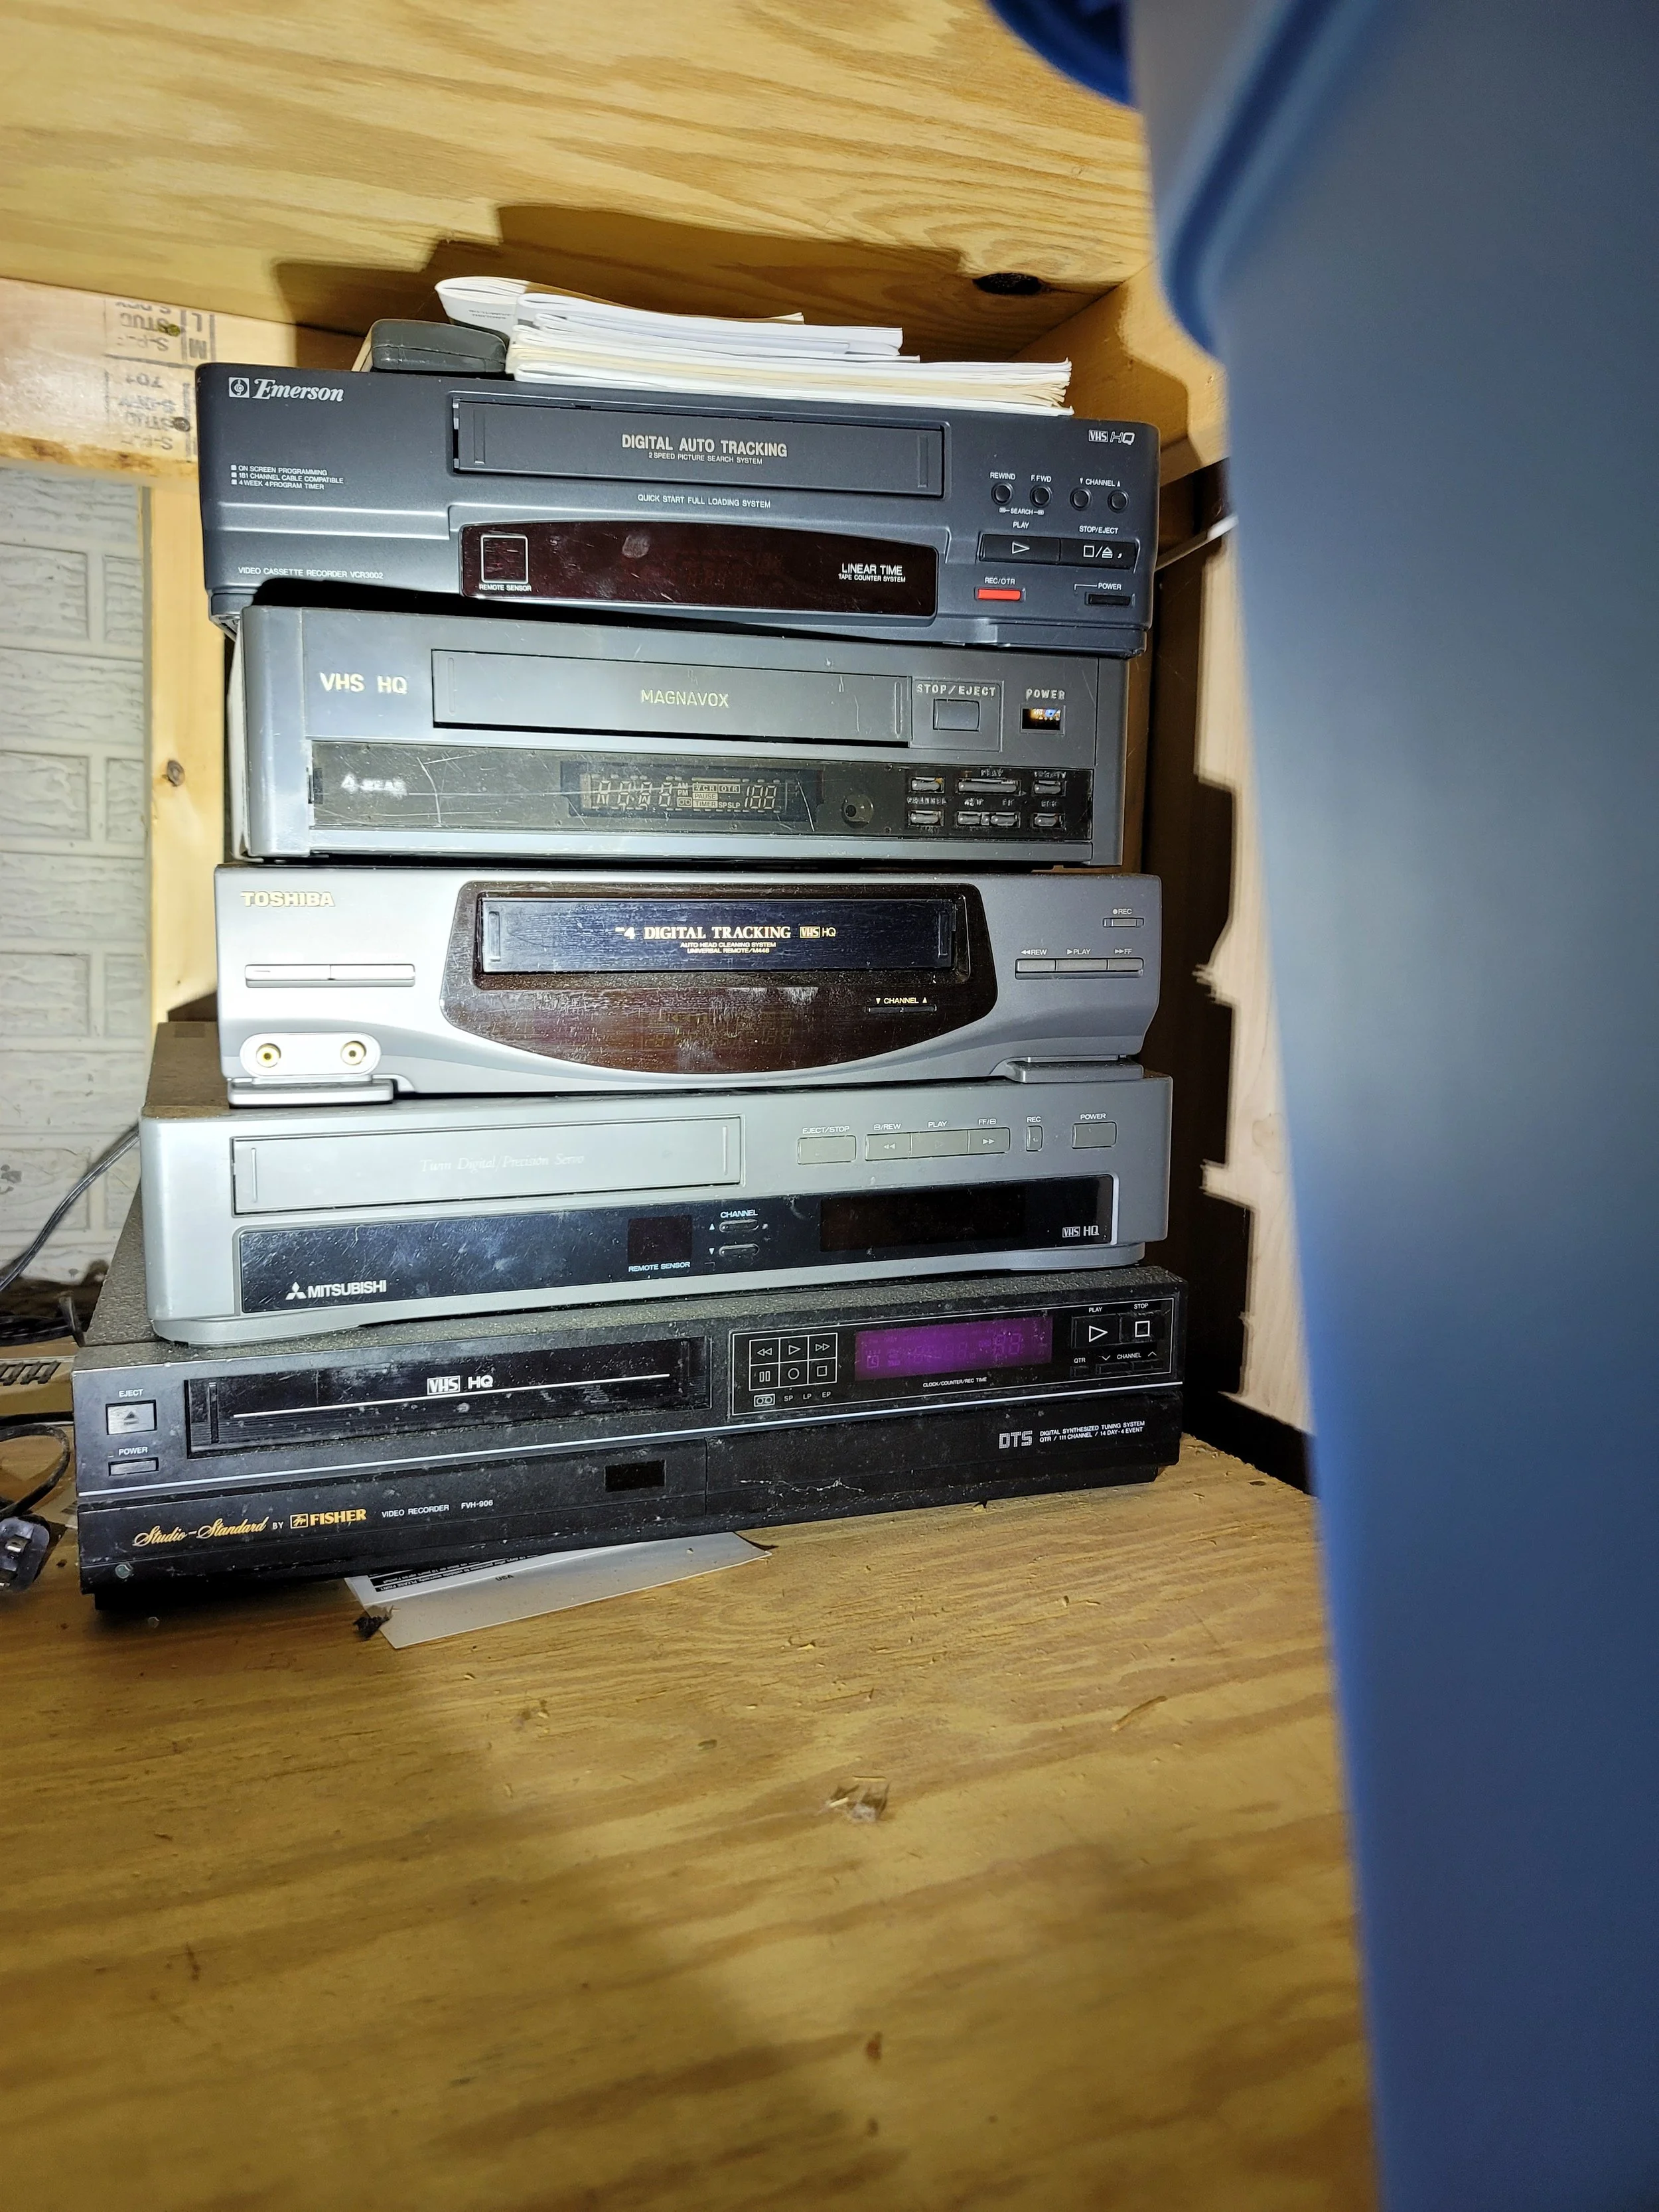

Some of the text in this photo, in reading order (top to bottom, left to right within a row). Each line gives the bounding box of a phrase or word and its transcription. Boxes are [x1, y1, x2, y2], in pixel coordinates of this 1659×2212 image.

[252, 378, 344, 402] Emerson
[1088, 429, 1135, 445] VHS HQ
[622, 434, 788, 457] DIGITAL AUTO TRACKING
[278, 467, 328, 476] PROGRAMMING
[990, 472, 1016, 480] REWIND
[1085, 478, 1116, 487] CHANNEL
[638, 494, 771, 508] QUICK START FULL LOADING SYSTEM
[1079, 526, 1119, 534] STOP/EJECT
[307, 569, 348, 578] RECORDER
[350, 571, 384, 580] VCR3002
[841, 563, 902, 576] LINEAR TIME
[883, 575, 906, 583] SYSTEM
[984, 577, 1016, 586] REC/OTR
[1098, 582, 1121, 591] POWER
[319, 672, 408, 695] VHS HQ
[916, 684, 995, 697] STOP/EJECT
[1025, 688, 1065, 700] POWER
[641, 689, 729, 707] MAGNAVOX
[693, 784, 717, 792] VCR
[720, 784, 739, 793] OTR
[240, 891, 336, 908] TOSHIBA
[644, 926, 706, 939] DIGITAL
[711, 926, 791, 939] TRACKING
[800, 926, 820, 938] VHS
[822, 927, 837, 937] HQ
[802, 1126, 850, 1134] EJECT/STOP
[554, 1153, 585, 1165] Servo
[720, 1209, 758, 1218] CHANNEL
[1062, 1225, 1100, 1238] VHS HQ
[628, 1261, 691, 1272] REMOTE SENSOR
[307, 1280, 387, 1299] MITSUBISHI
[427, 1374, 494, 1395] VHS HQ
[922, 1378, 974, 1388] CLOCK/COUNTER/REC
[119, 1388, 143, 1398] EJECT
[999, 1430, 1033, 1449] DTS
[1062, 1425, 1099, 1434] SYNTHESIZED
[118, 1446, 148, 1455] POWER
[272, 1521, 284, 1530] BY
[310, 1509, 367, 1526] FISHER
[382, 1509, 405, 1518] VIDEO
[407, 1504, 450, 1515] RECORDER
[461, 1499, 493, 1510] FVH-906
